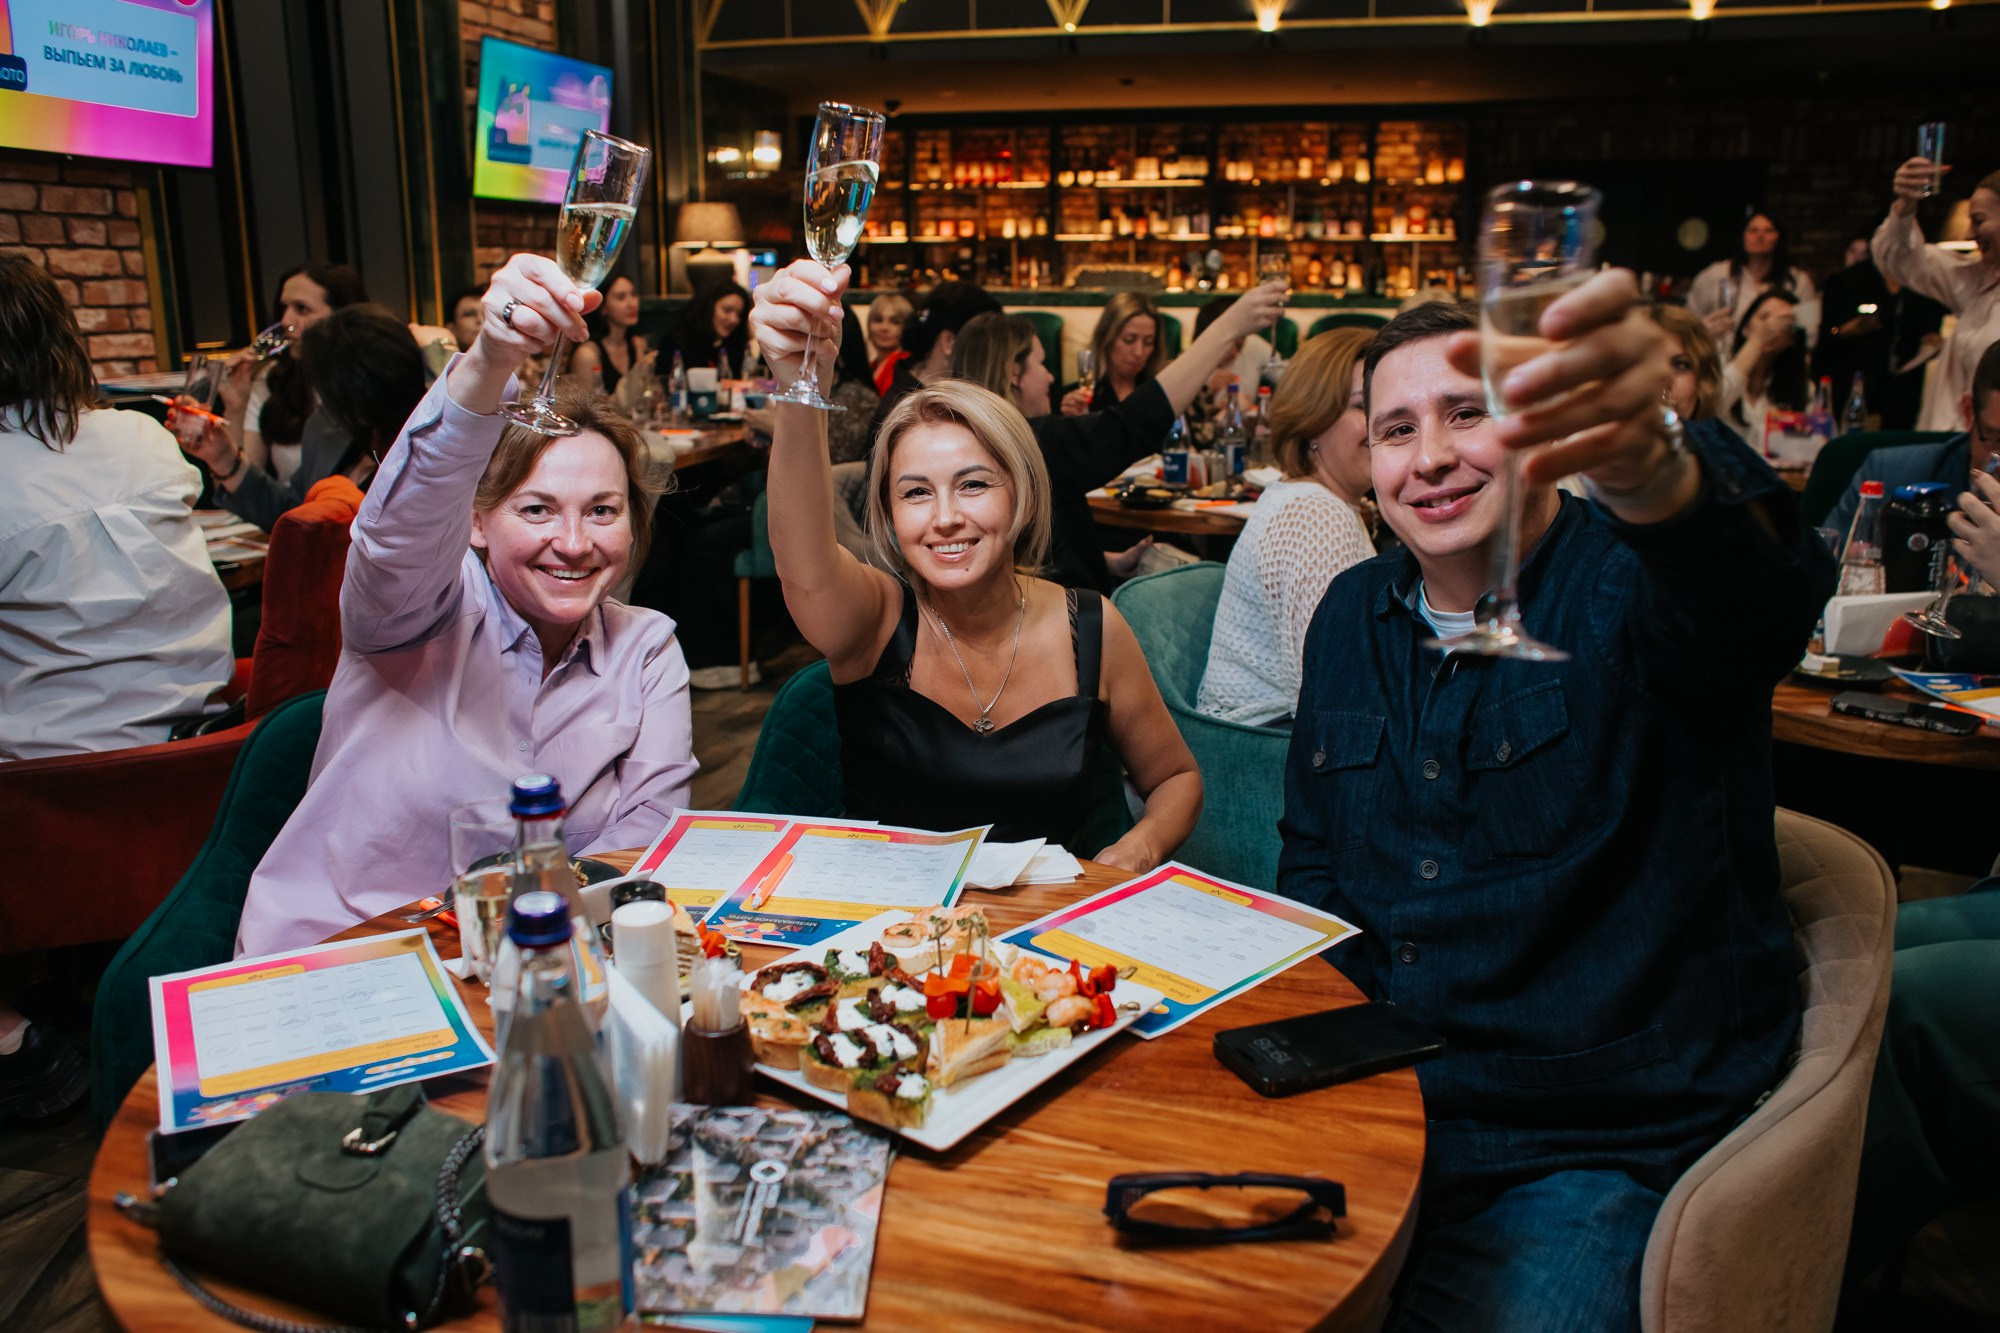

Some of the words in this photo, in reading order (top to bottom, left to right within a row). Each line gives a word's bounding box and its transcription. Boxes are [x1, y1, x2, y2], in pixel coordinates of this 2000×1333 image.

[48, 20, 95, 43] ИГОРЬ
[98, 30, 168, 58] НИКОЛАЕВ
[43, 45, 106, 70] ВЫПЬЕМ
[110, 57, 126, 73] ЗА
[128, 61, 183, 83] ЛЮБОВЬ
